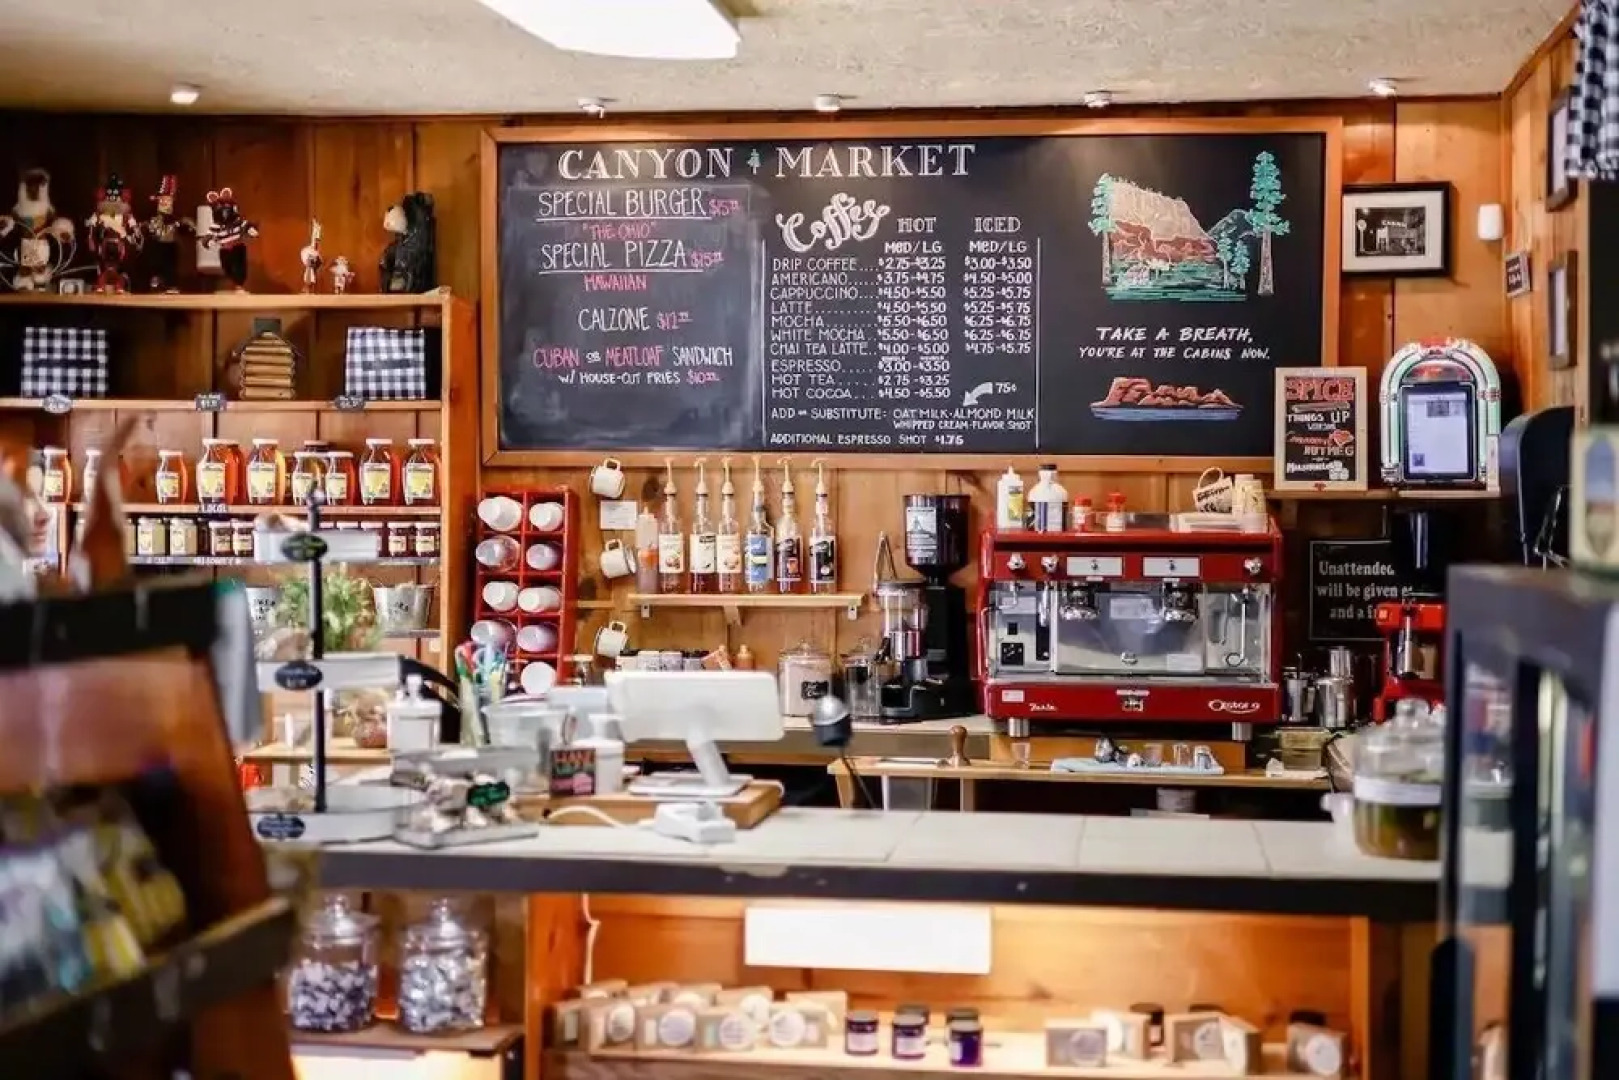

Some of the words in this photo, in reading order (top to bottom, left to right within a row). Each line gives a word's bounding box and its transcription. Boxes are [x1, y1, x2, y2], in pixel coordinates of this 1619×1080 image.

[557, 147, 734, 180] CANYON
[775, 144, 976, 178] MARKET
[538, 190, 617, 217] SPECIAL
[625, 187, 707, 217] BURGER
[775, 192, 891, 252] Coffee
[897, 216, 937, 234] HOT
[974, 216, 1021, 233] ICED
[540, 241, 612, 270] SPECIAL
[625, 240, 687, 268] PIZZA
[773, 258, 802, 271] DRIP
[807, 257, 858, 271] COFFEE
[771, 272, 848, 286] AMERICANO
[770, 287, 859, 300] CAPPUCCINO
[771, 302, 813, 314] LATTE
[578, 306, 651, 332] CALZONE
[771, 316, 825, 327] MOCHA
[770, 329, 812, 341] WHITE
[819, 329, 865, 341] MOCHA
[1096, 326, 1147, 341] TAKE
[1155, 326, 1170, 341] A
[1179, 326, 1254, 343] BREATH,
[770, 342, 800, 355] CHAI
[805, 343, 828, 355] TEA
[832, 342, 868, 355] LATTE
[1079, 346, 1126, 358] YOU'RE
[1130, 346, 1146, 358] AT
[1153, 347, 1176, 358] THE
[1183, 347, 1232, 359] CABINS
[1241, 347, 1271, 359] NOW.
[532, 347, 580, 369] CUBAN
[605, 344, 665, 367] MEATLOAF
[672, 346, 733, 367] SANDWICH
[771, 358, 842, 372] ESPRESSO
[771, 374, 802, 386] HOT
[809, 374, 836, 386] TEA
[771, 387, 801, 399] HOT
[806, 388, 852, 399] COCOA
[771, 407, 796, 420] ADD
[811, 407, 888, 420] SUBSTITUTE:
[893, 408, 917, 419] OAT
[1006, 408, 1035, 419] MILK
[1330, 411, 1350, 423] UP
[1007, 420, 1032, 430] SHOT
[770, 433, 833, 444] ADDITIONAL
[838, 434, 891, 445] ESPRESSO
[899, 434, 927, 445] SHOT
[1317, 582, 1343, 597] will
[1346, 582, 1361, 597] be
[1363, 582, 1398, 602] given
[1329, 604, 1355, 619] and
